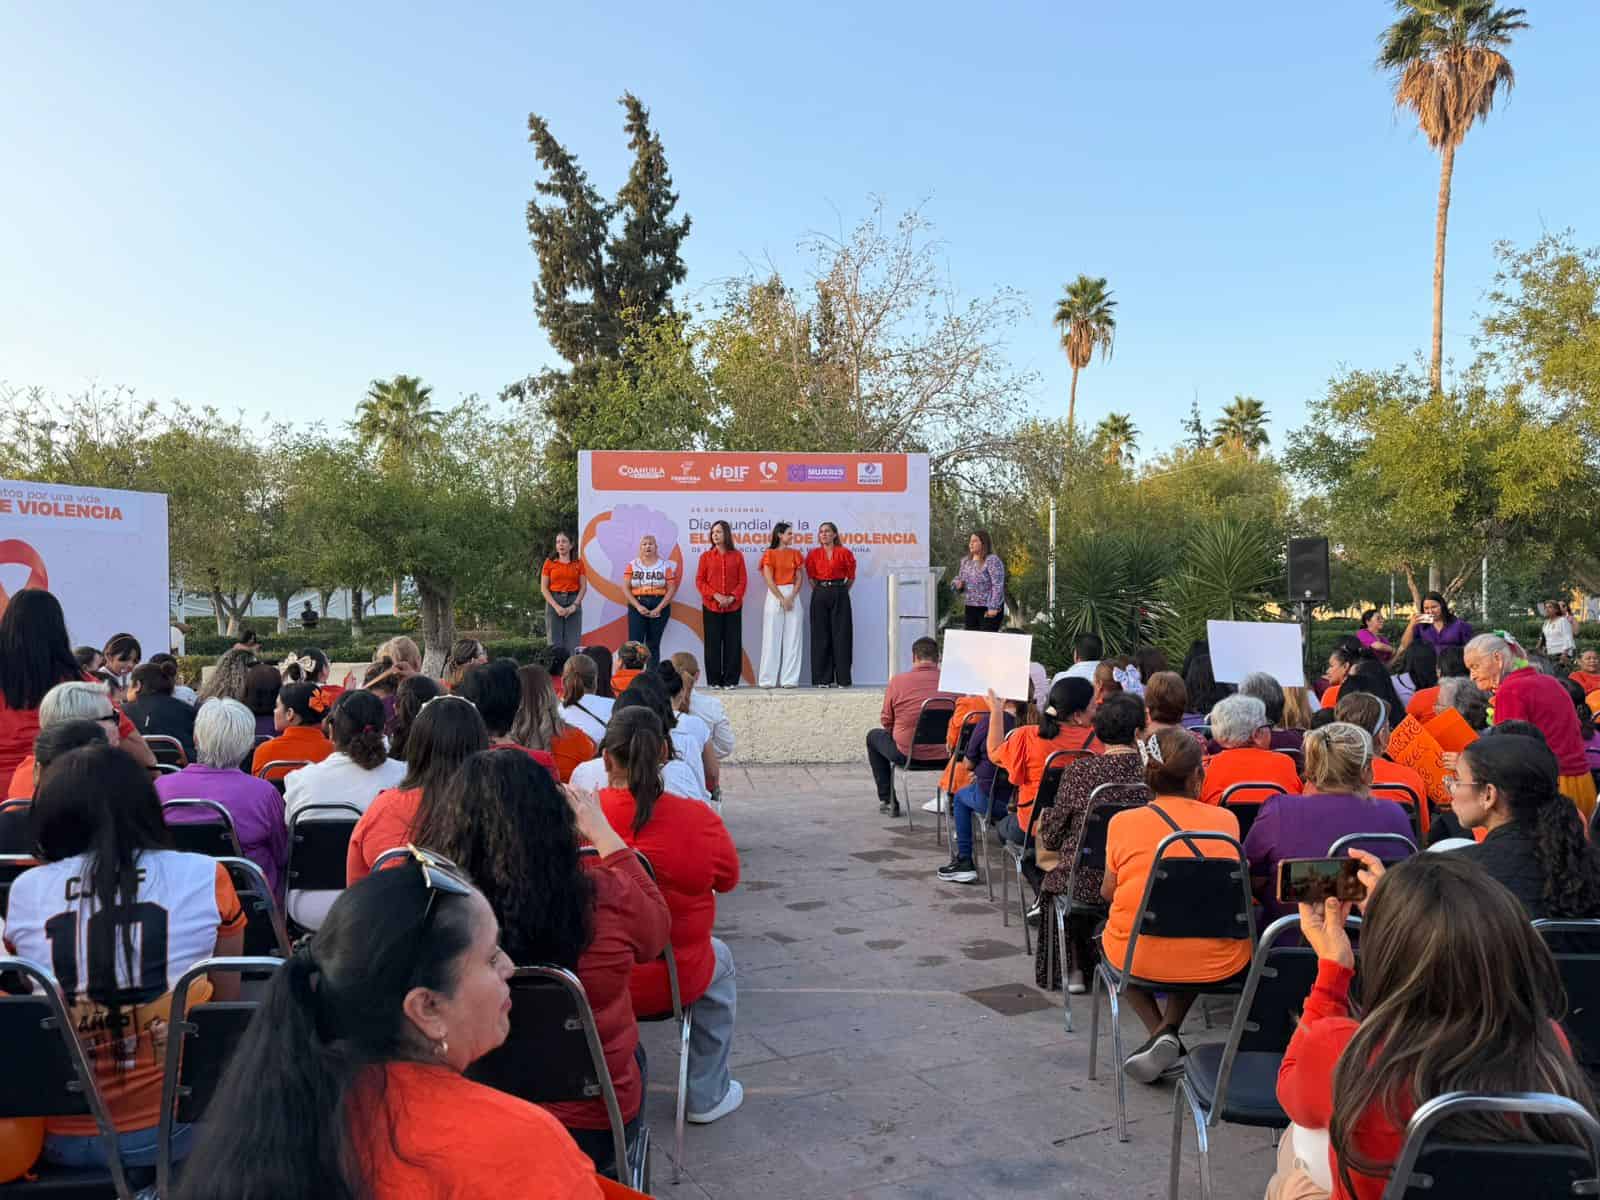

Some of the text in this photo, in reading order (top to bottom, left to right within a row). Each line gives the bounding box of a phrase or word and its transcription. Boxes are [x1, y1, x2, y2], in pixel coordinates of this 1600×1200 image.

[722, 466, 750, 479] DIF
[18, 500, 123, 521] VIOLENCIA
[729, 519, 771, 530] undial
[794, 532, 814, 545] DE
[839, 532, 918, 545] VIOLENCIA
